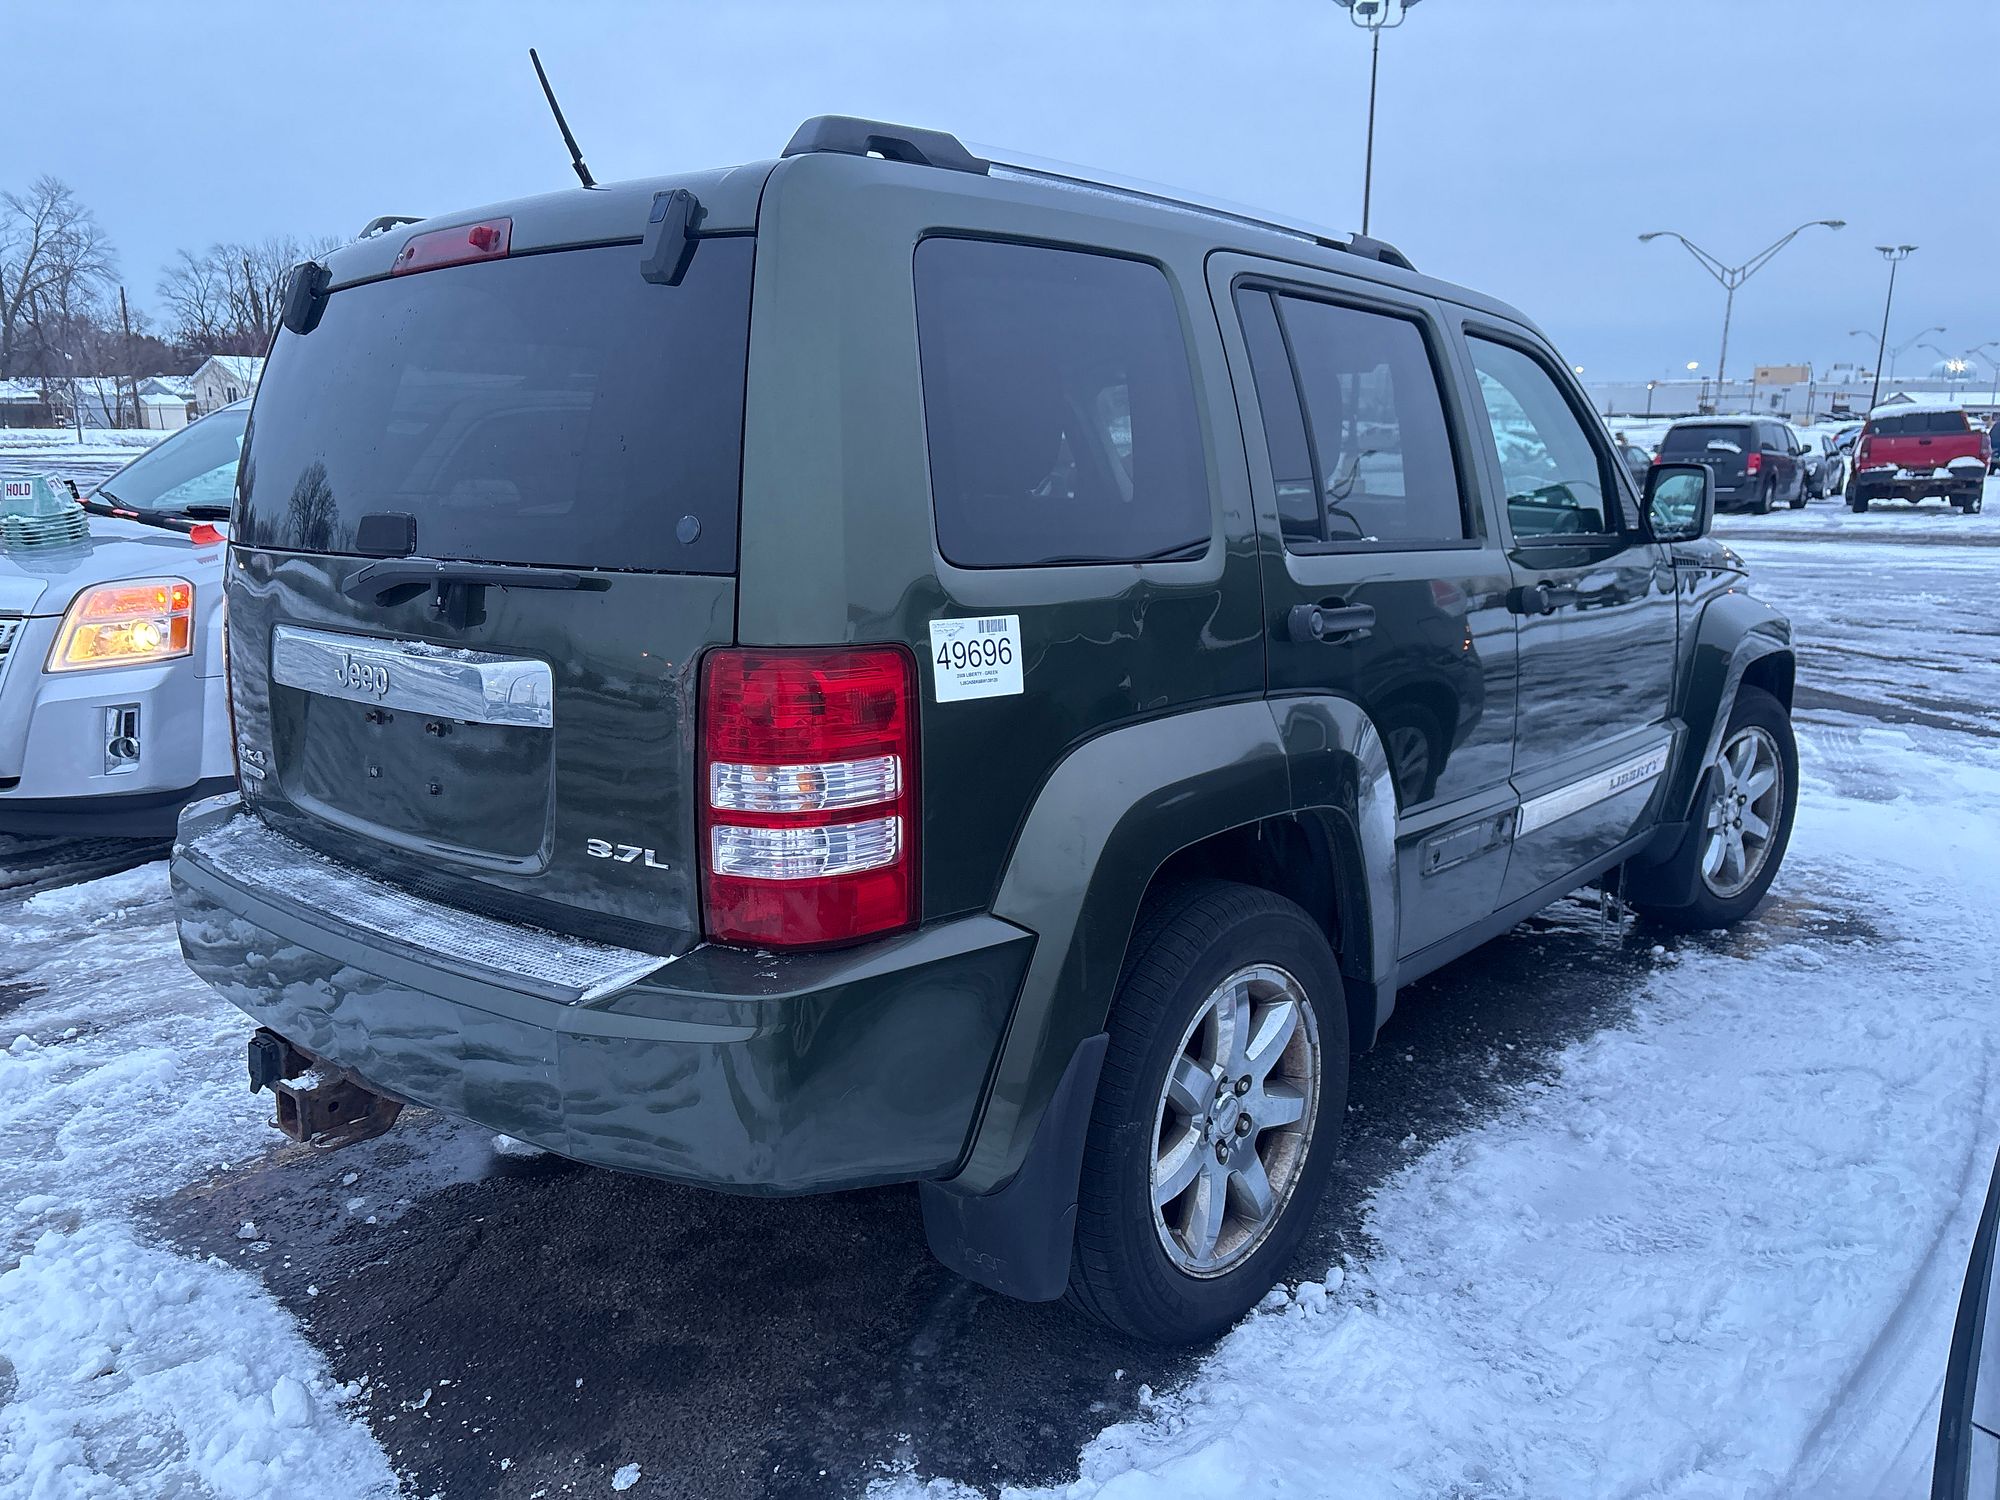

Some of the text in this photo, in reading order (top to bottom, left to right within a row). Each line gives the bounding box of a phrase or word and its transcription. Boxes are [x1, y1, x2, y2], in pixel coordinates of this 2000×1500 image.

[6, 483, 30, 496] HOLD
[937, 637, 1012, 670] 49696
[334, 654, 389, 701] Jeep
[1608, 758, 1660, 791] LIBERTY
[587, 838, 669, 870] 3.7L
